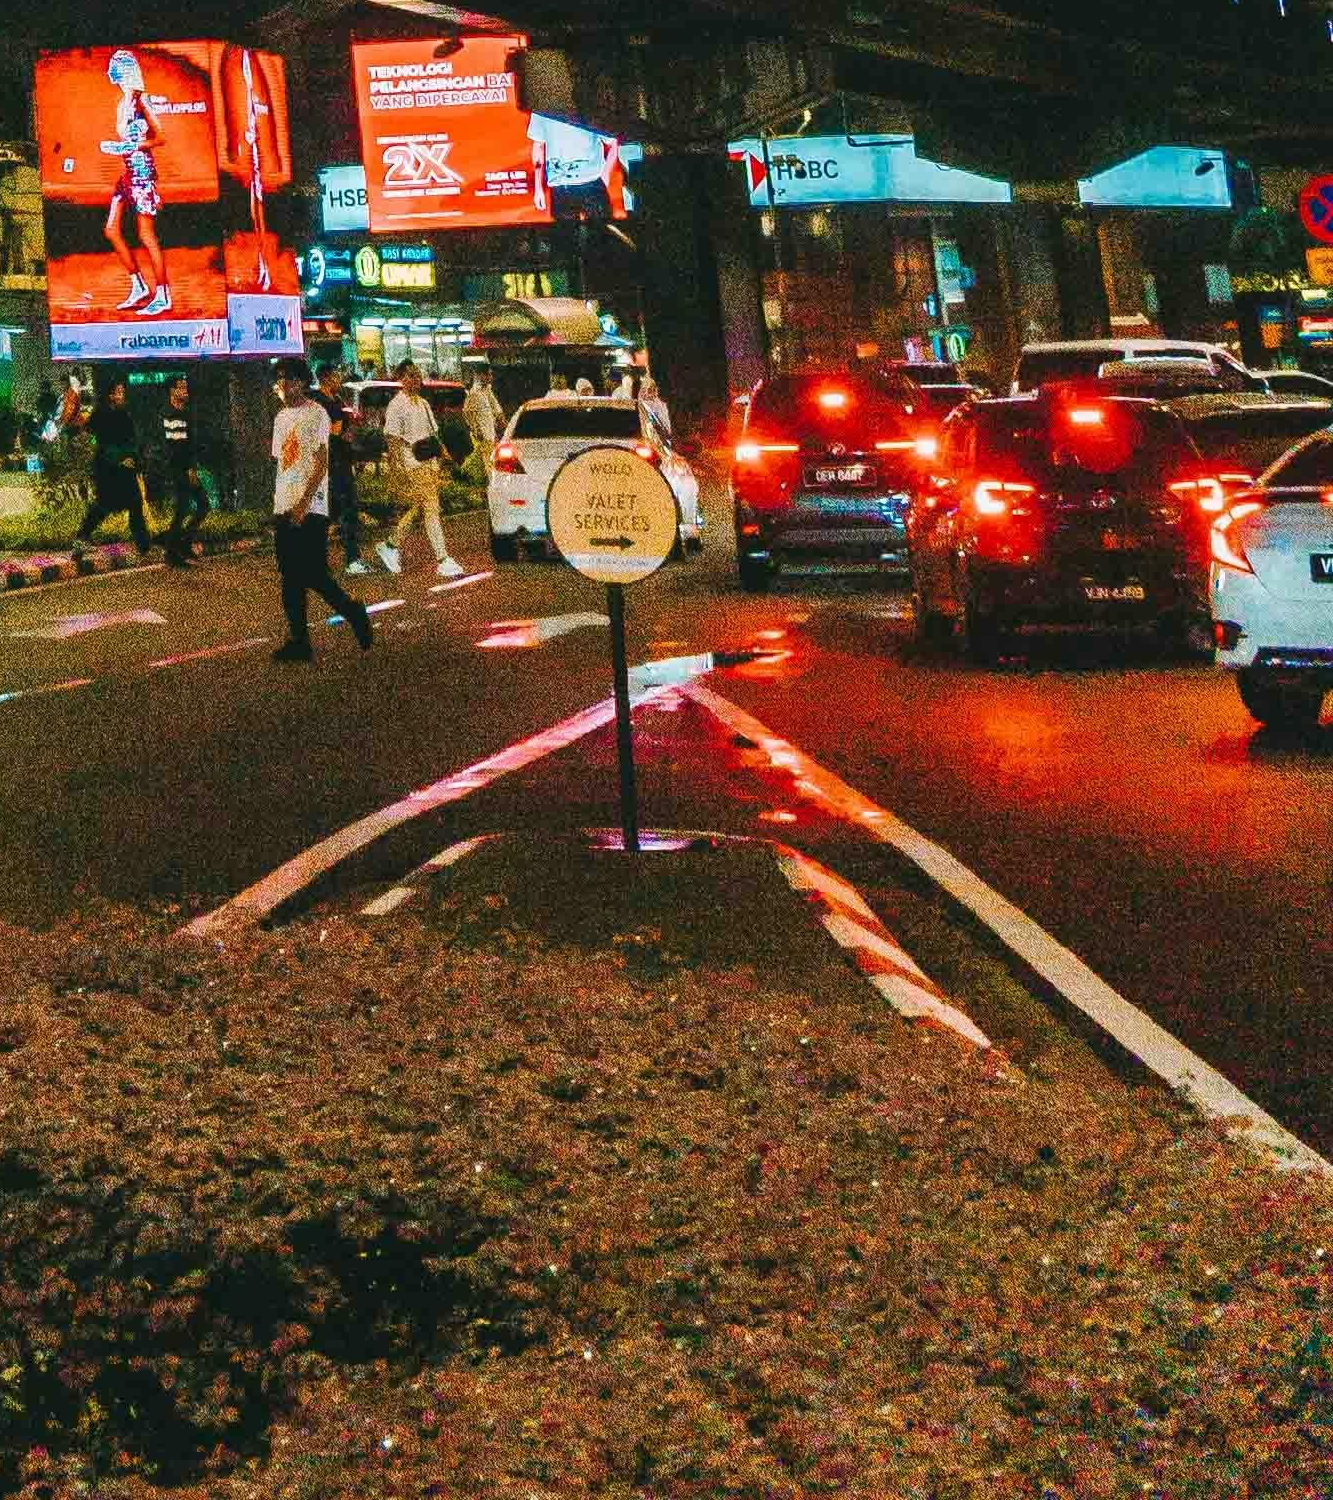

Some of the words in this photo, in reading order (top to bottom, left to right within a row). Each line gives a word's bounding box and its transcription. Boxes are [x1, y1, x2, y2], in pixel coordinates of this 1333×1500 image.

[370, 94, 413, 110] YANG
[328, 188, 369, 208] HSB
[118, 332, 190, 350] rabanne
[586, 492, 637, 510] VALET
[573, 513, 650, 532] SERVICES
